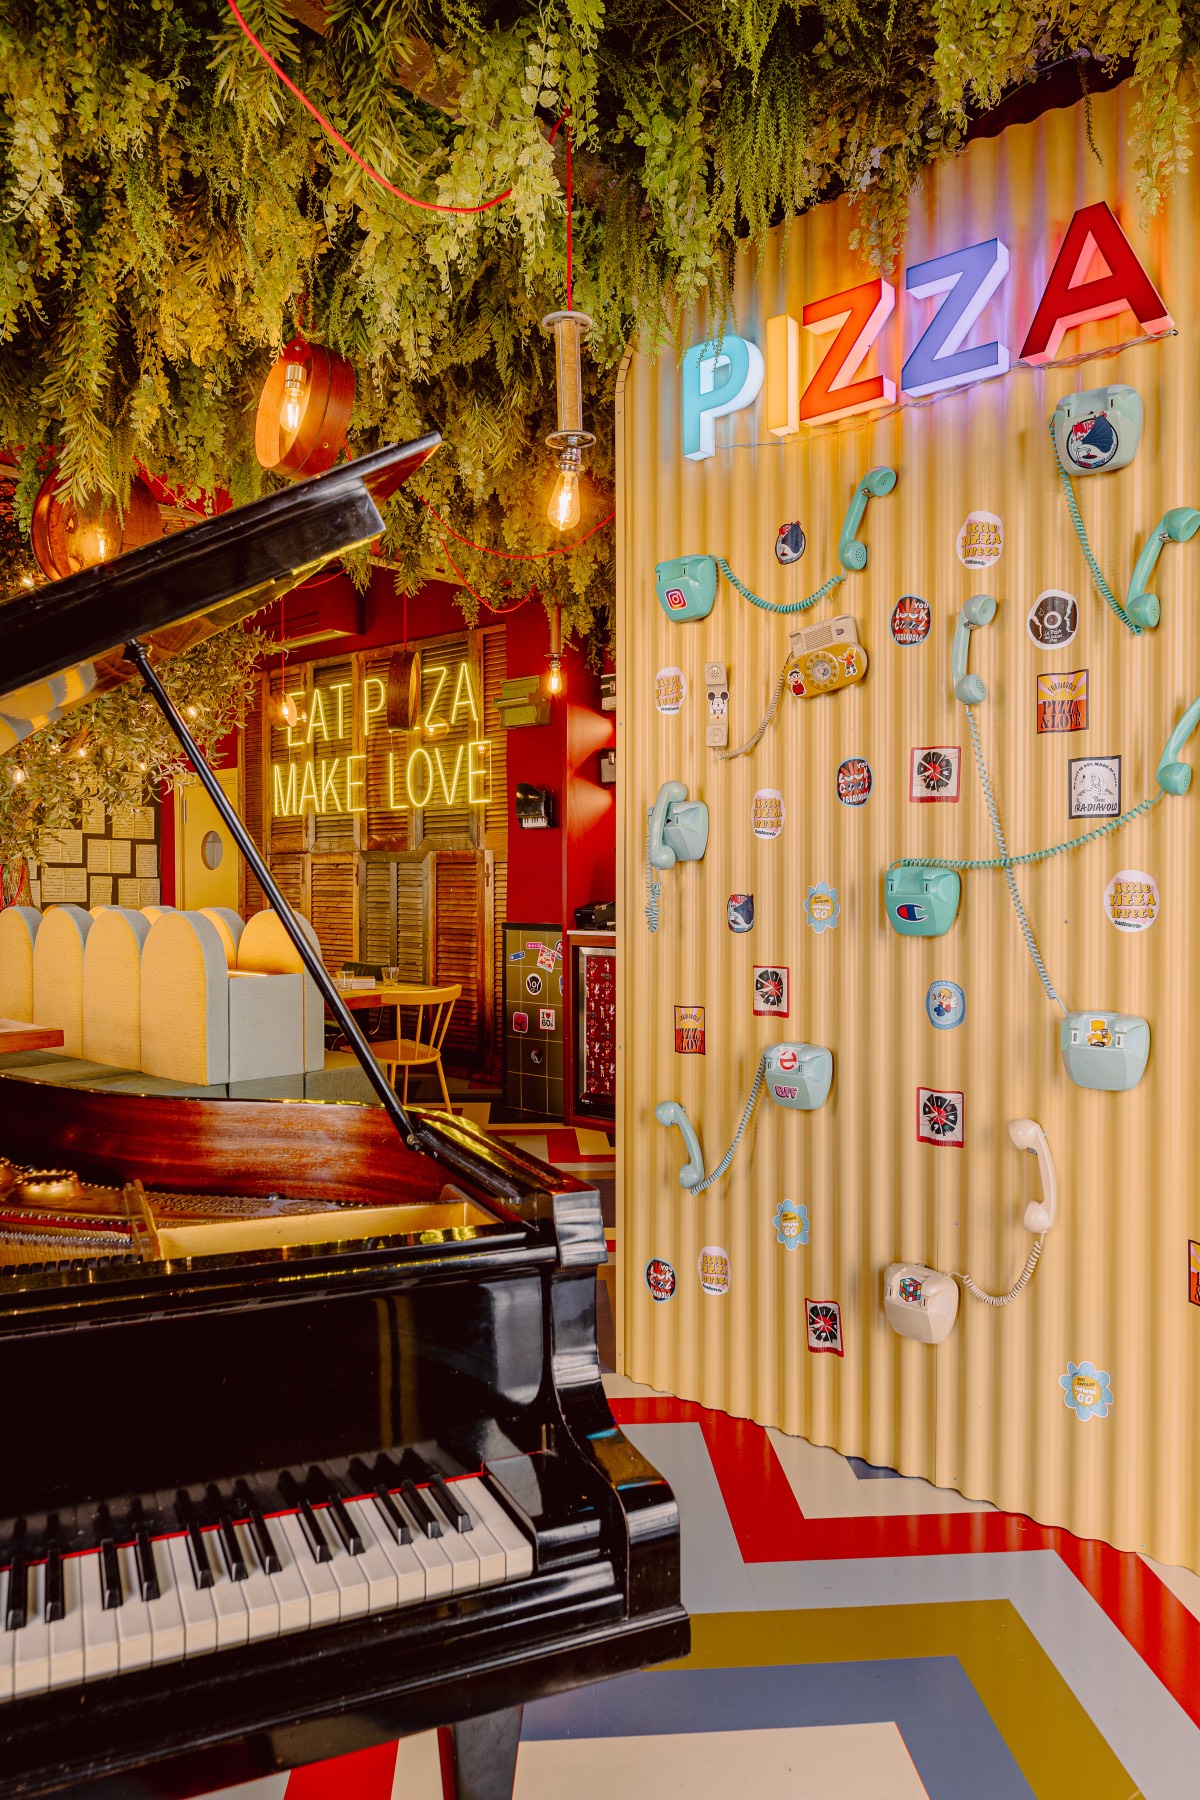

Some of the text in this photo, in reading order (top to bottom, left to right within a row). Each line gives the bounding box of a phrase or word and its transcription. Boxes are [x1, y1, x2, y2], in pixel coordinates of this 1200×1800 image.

[682, 200, 1177, 461] PIZZA
[895, 607, 928, 620] LOOK
[1042, 699, 1081, 714] PIZZA
[287, 682, 353, 747] EAT
[274, 739, 492, 817] MAKE LOVE
[1113, 881, 1152, 894] little
[1109, 893, 1157, 906] PIZZA
[1111, 906, 1155, 919] lovers
[774, 1084, 799, 1100] BFF
